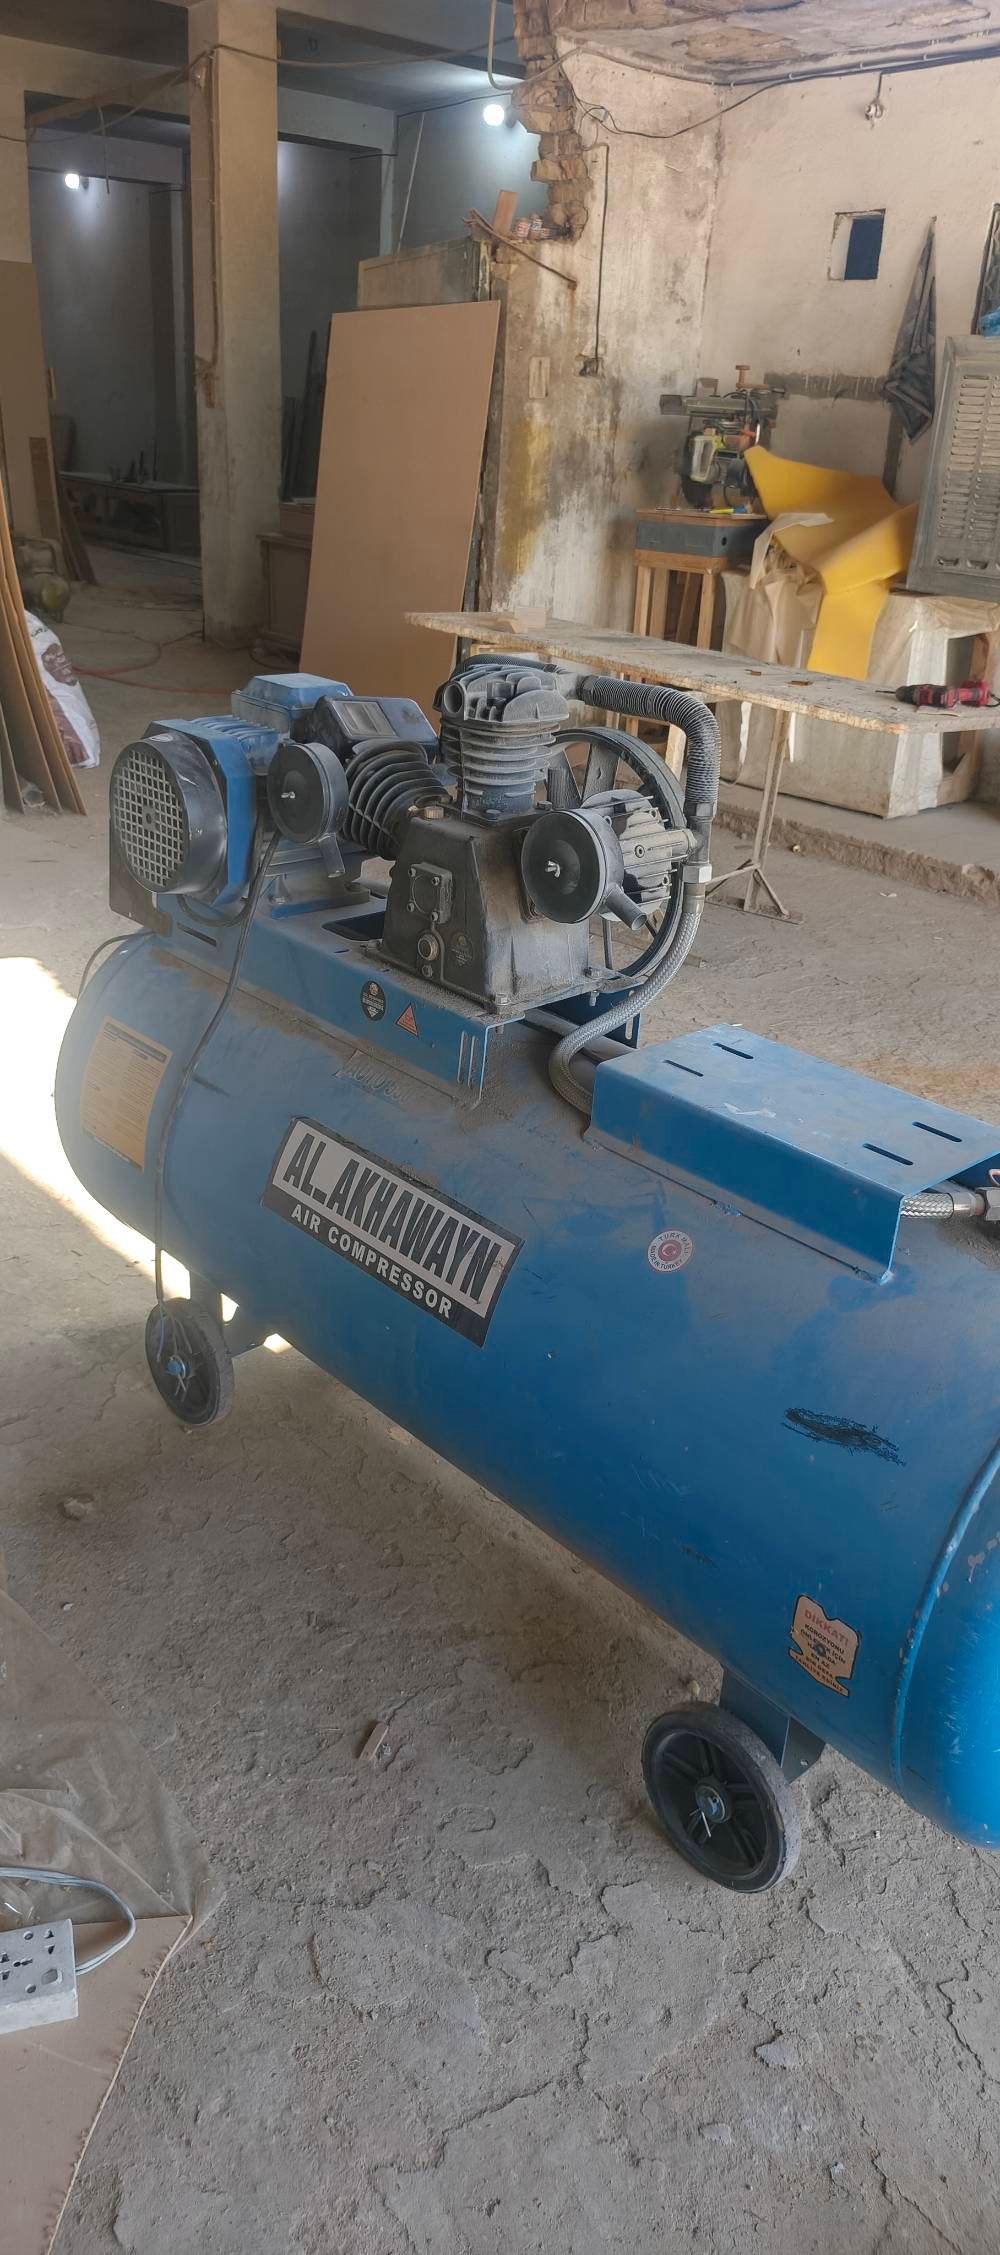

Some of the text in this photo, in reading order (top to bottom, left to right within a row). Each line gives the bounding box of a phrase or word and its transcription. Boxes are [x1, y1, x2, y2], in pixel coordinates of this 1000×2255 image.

[291, 1204, 452, 1318] AIR COMPRESSOR
[804, 1623, 845, 1655] KOROZYONU
